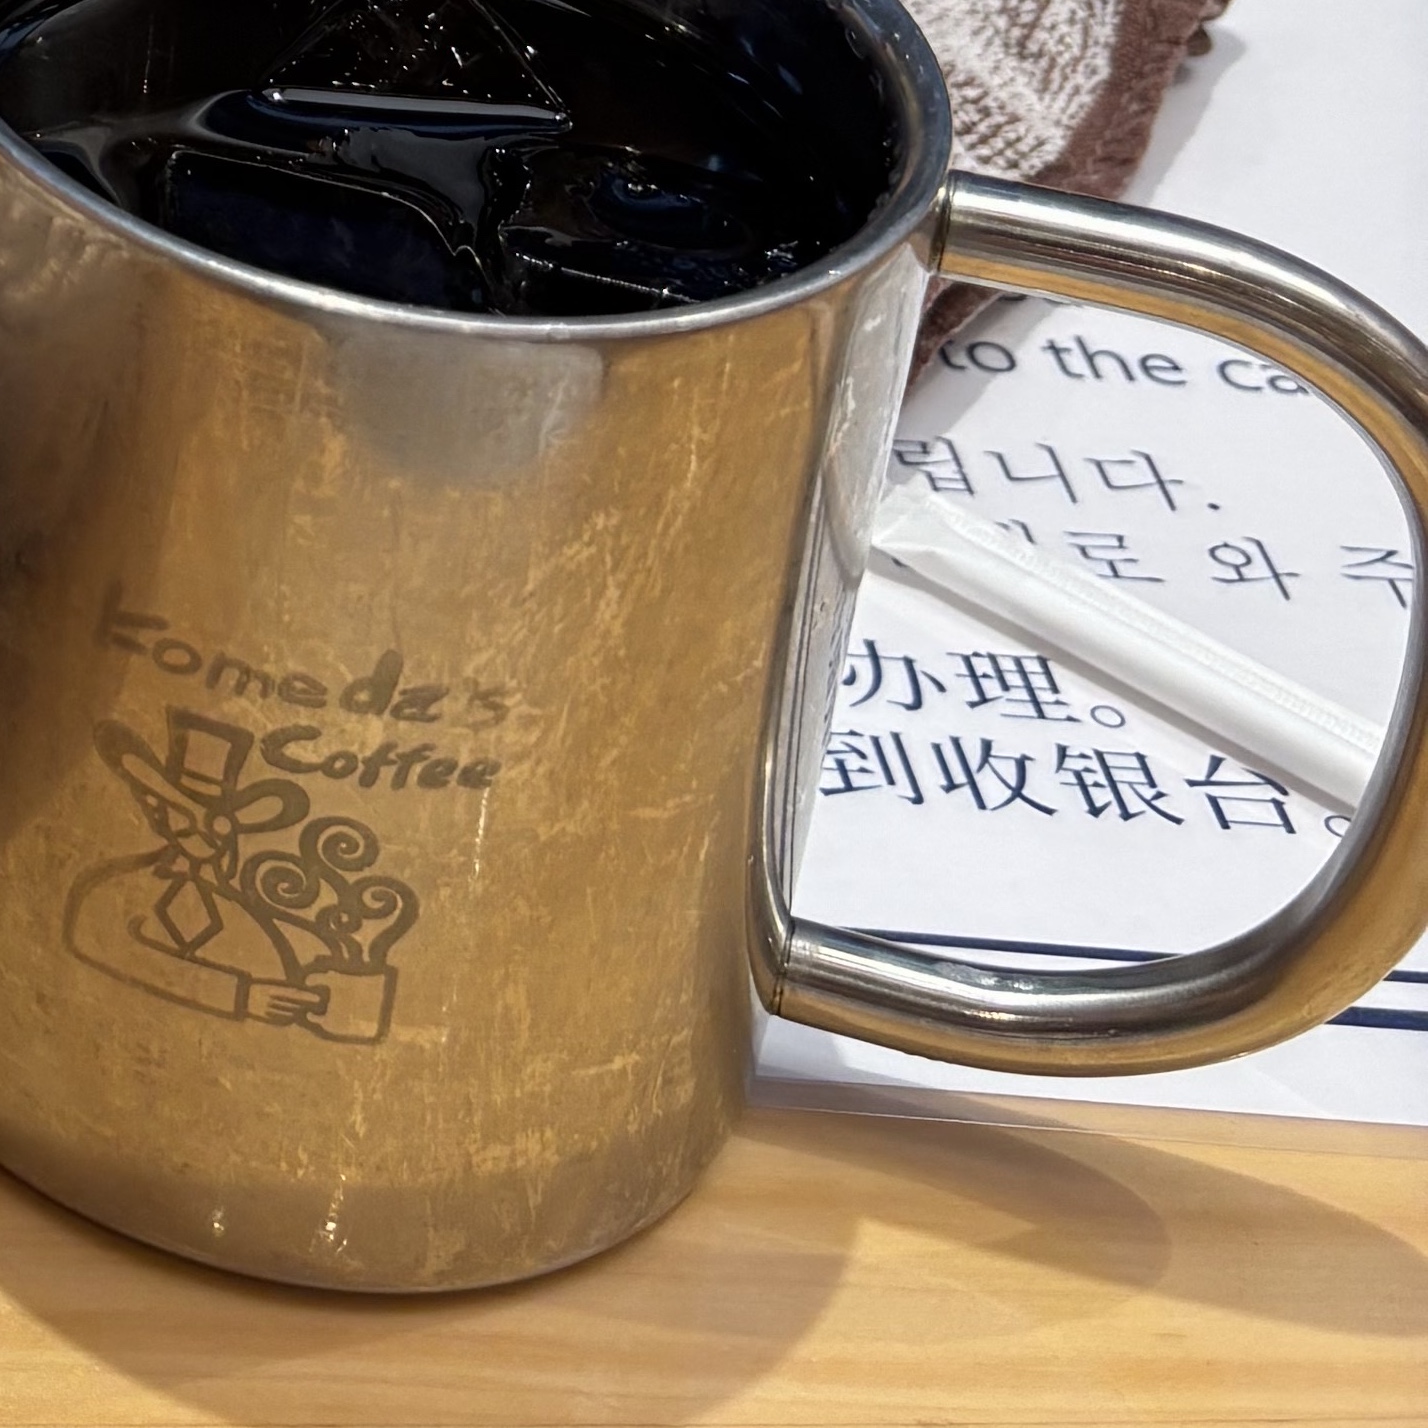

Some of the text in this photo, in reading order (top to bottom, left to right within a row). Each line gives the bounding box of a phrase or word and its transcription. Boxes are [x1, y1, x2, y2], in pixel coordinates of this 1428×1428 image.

[1042, 335, 1189, 387] the
[1207, 535, 1302, 601] 와
[841, 638, 1126, 729] 办理。
[260, 723, 502, 791] Coffee
[819, 730, 1351, 838] 到收银台。
